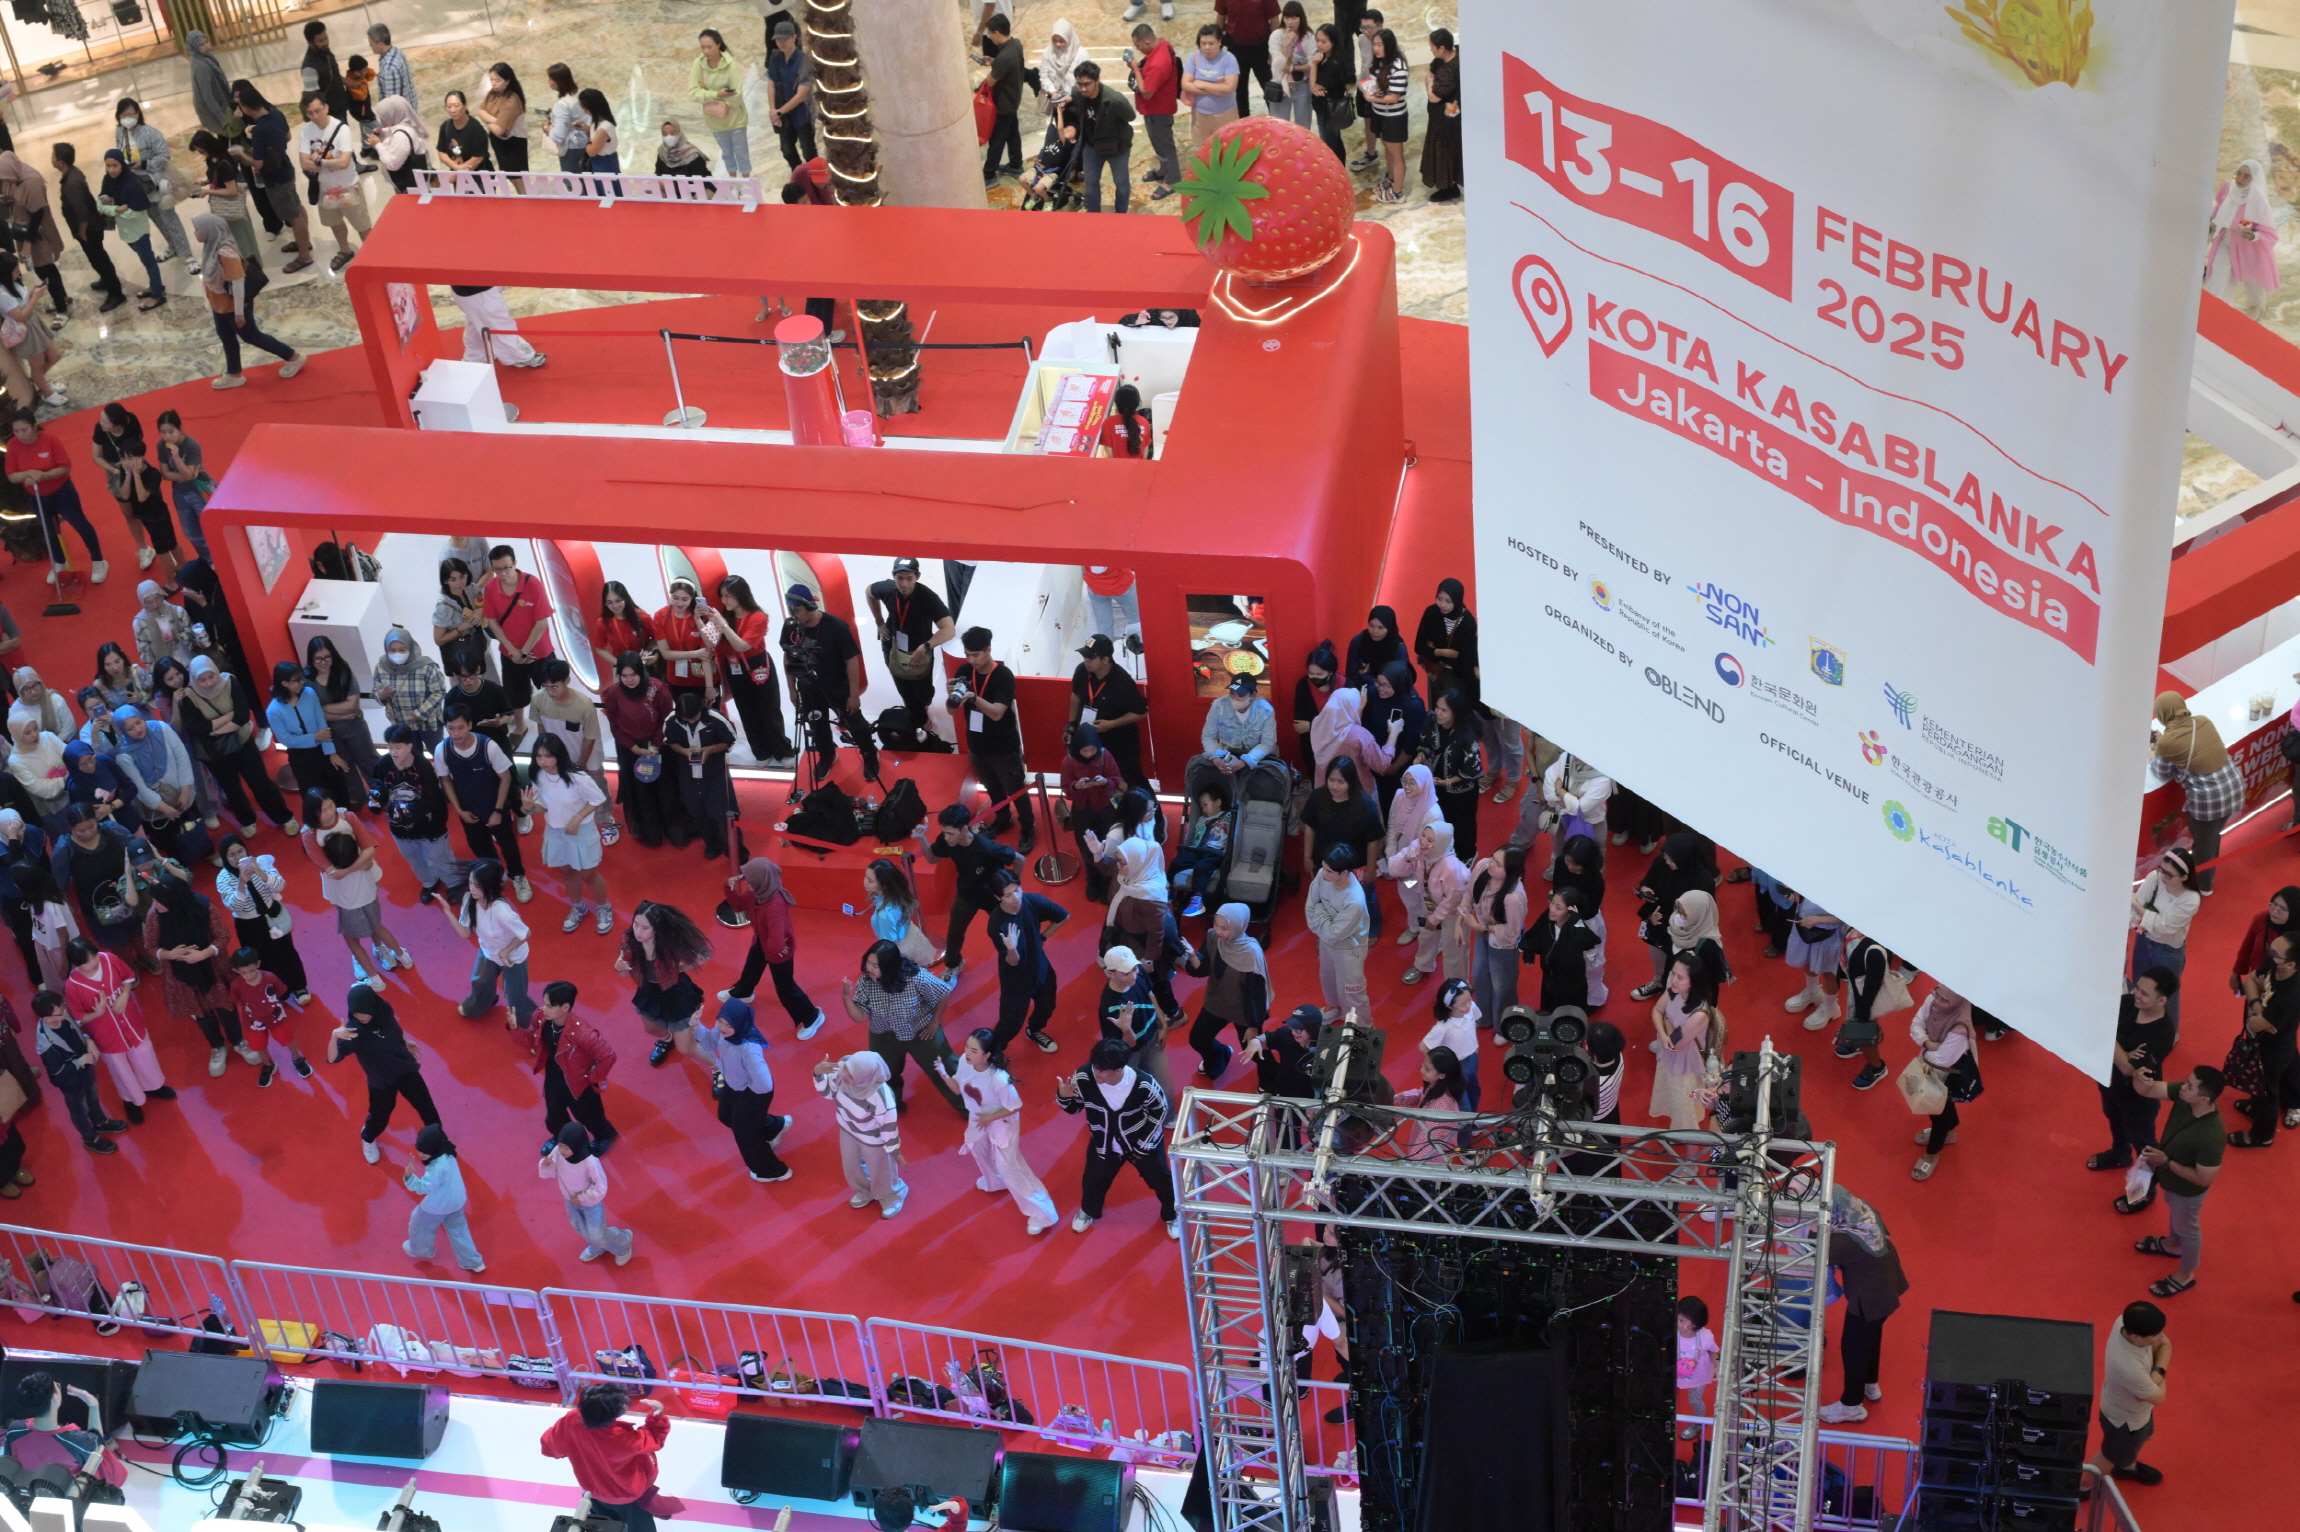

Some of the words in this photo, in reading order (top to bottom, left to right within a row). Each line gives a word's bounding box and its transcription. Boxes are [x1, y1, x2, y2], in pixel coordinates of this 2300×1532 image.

[1816, 205, 2129, 394] FEBRUARY
[1816, 277, 1965, 370] 2025
[1588, 291, 1719, 385] KOTA
[1737, 359, 2102, 596] KASABLANKA
[1617, 372, 1788, 480] Jakarta
[1839, 476, 2069, 633] Indonesia
[1507, 536, 1558, 571] HOSTED
[1563, 563, 1579, 582] BY
[1579, 520, 1649, 575] PRESENTED
[1653, 568, 1672, 586] BY
[1618, 598, 1651, 626] Embassy
[1651, 619, 1661, 630] of
[1662, 624, 1676, 638] the
[1618, 608, 1651, 634] Republic
[1651, 629, 1661, 640] of
[1661, 635, 1686, 653] Korea
[1700, 582, 1760, 627] NON
[1705, 603, 1765, 647] SAN
[1544, 604, 1615, 655] ORGANIZED
[1618, 650, 1634, 668] BY
[1750, 674, 1817, 717] 한국문화원
[1750, 690, 1773, 704] Korean
[1921, 732, 1956, 761] REPUBLIK
[1958, 757, 2003, 784] INDONESIA
[1922, 723, 2003, 777] PERDAGANGAN
[1923, 714, 2004, 768] KEMENTERIAN
[1760, 732, 1822, 776] OFFICIAL
[1825, 767, 1870, 805] VENUE
[1890, 754, 1959, 807] 한국관광공사
[1986, 816, 2031, 854] aT
